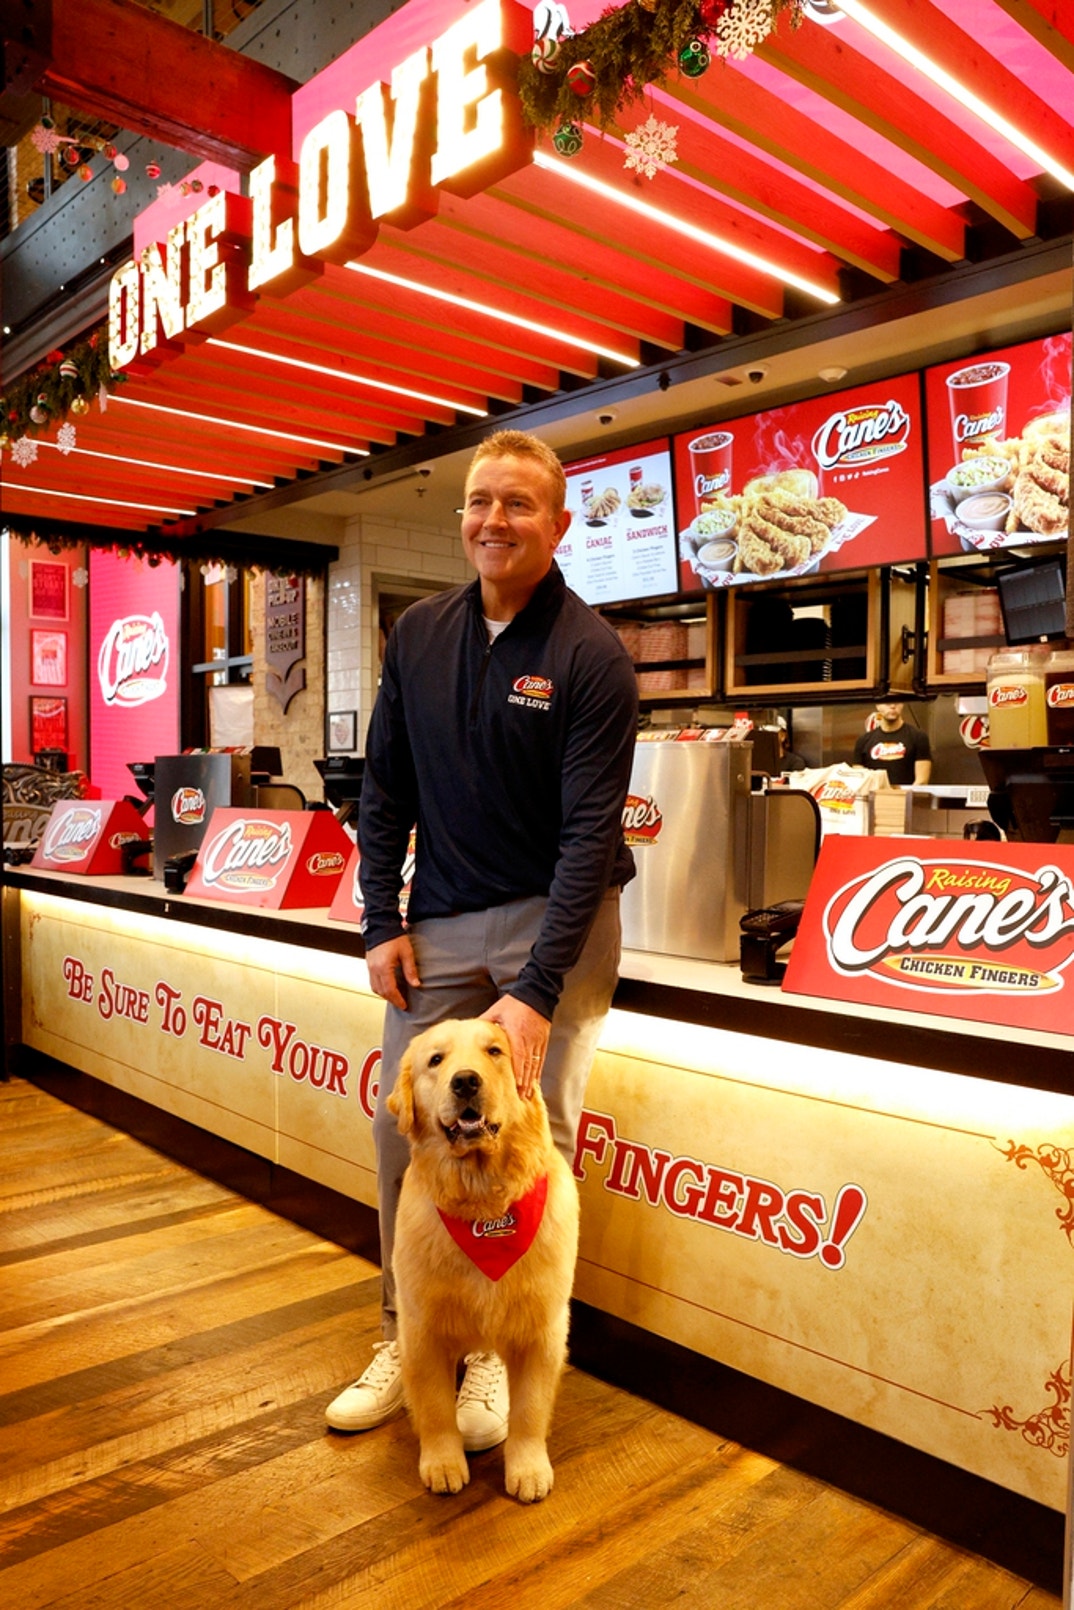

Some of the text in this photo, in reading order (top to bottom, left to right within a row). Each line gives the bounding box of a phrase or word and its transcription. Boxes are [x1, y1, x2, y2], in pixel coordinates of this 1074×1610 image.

[108, 0, 502, 370] ONE LOVE
[817, 400, 909, 468] Cane's
[953, 405, 1004, 442] Cane's
[100, 611, 168, 702] Cane's
[513, 675, 554, 692] Cane's
[990, 686, 1028, 708] Cane's
[507, 694, 552, 711] ONE LOVE
[621, 795, 663, 829] ne's
[44, 808, 101, 858] Cane's
[205, 819, 293, 883] Cane's
[309, 852, 344, 873] Cane's
[925, 868, 1012, 896] Raising
[831, 859, 1074, 971] Cane's
[900, 957, 1040, 987] CHICKEN FINGERS
[63, 956, 94, 1003] BE
[98, 968, 150, 1023] SURE
[155, 981, 187, 1037] TO
[193, 995, 252, 1060] EAT
[257, 1016, 349, 1097] YOUR
